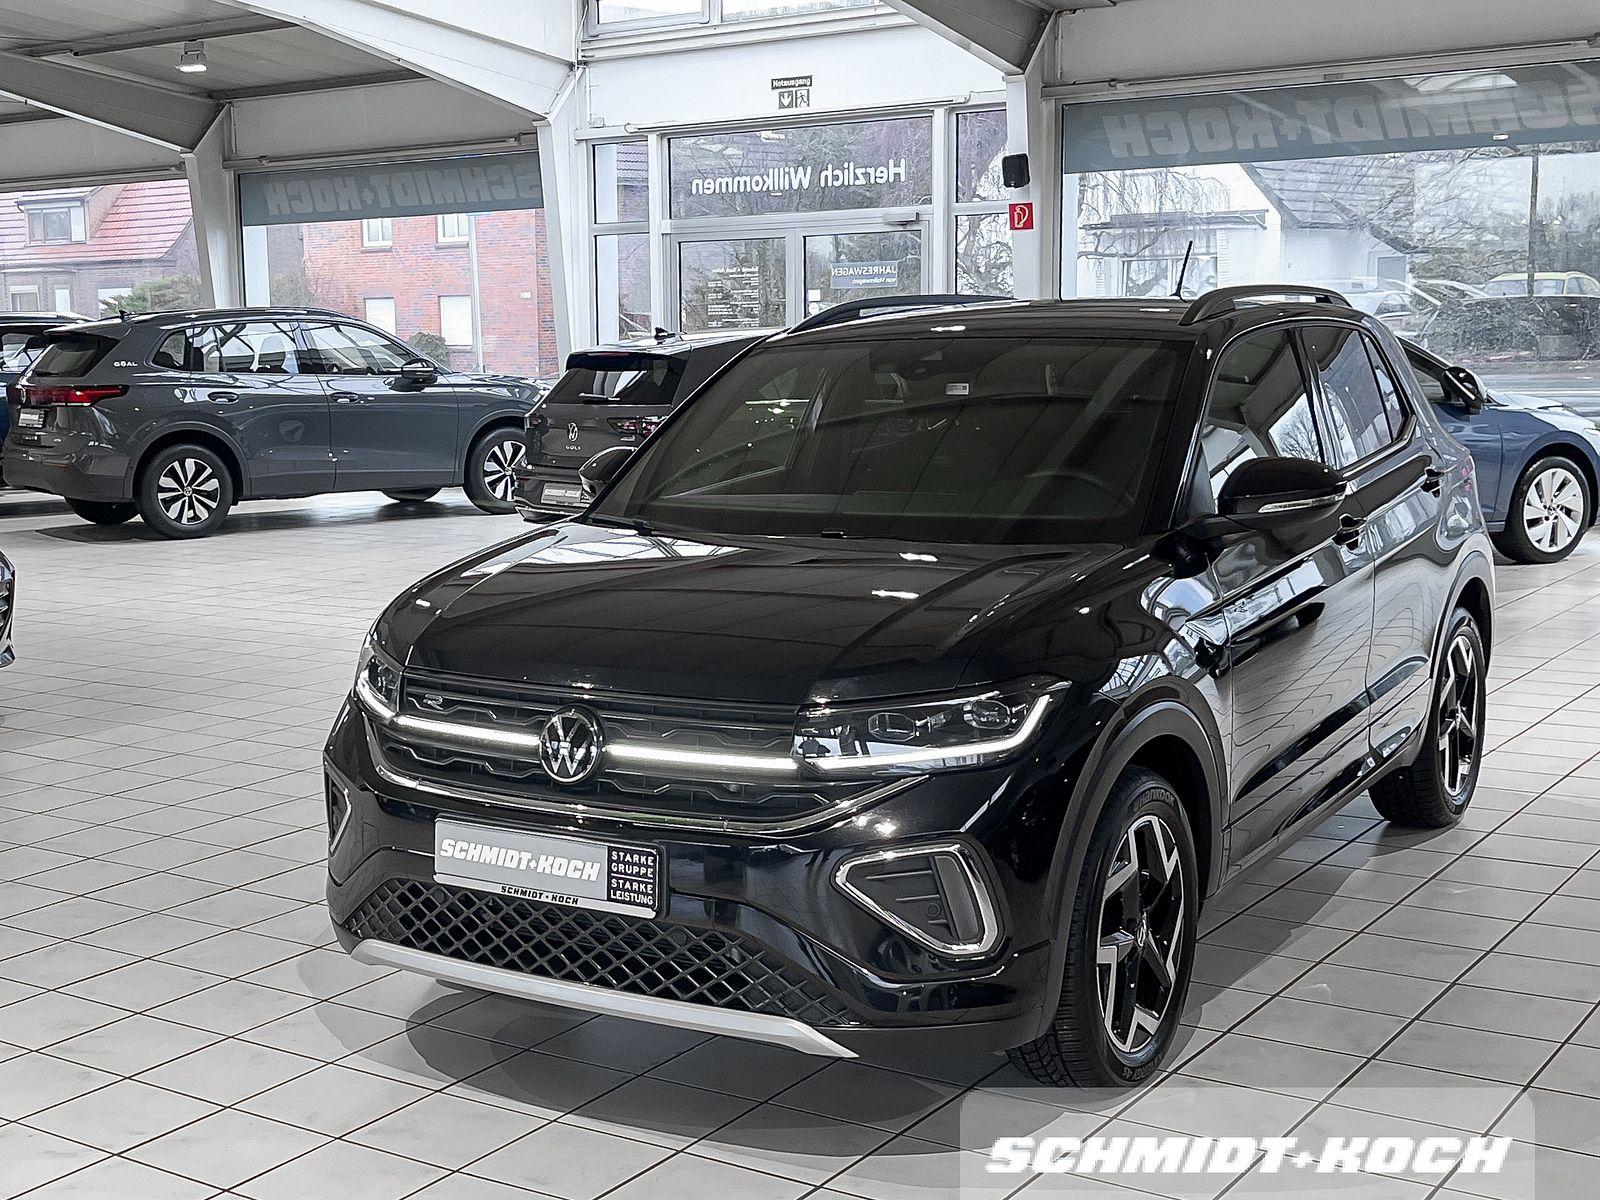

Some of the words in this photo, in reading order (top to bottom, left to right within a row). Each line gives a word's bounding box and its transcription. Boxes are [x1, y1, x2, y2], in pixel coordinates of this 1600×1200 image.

[773, 78, 811, 87] Notausgang
[611, 851, 654, 866] STARKE
[611, 863, 654, 878] GRUPPE
[611, 879, 653, 894] STARKE
[501, 885, 544, 900] SCHMIDT
[551, 894, 579, 906] KOCH
[610, 890, 653, 905] LEISTUNG
